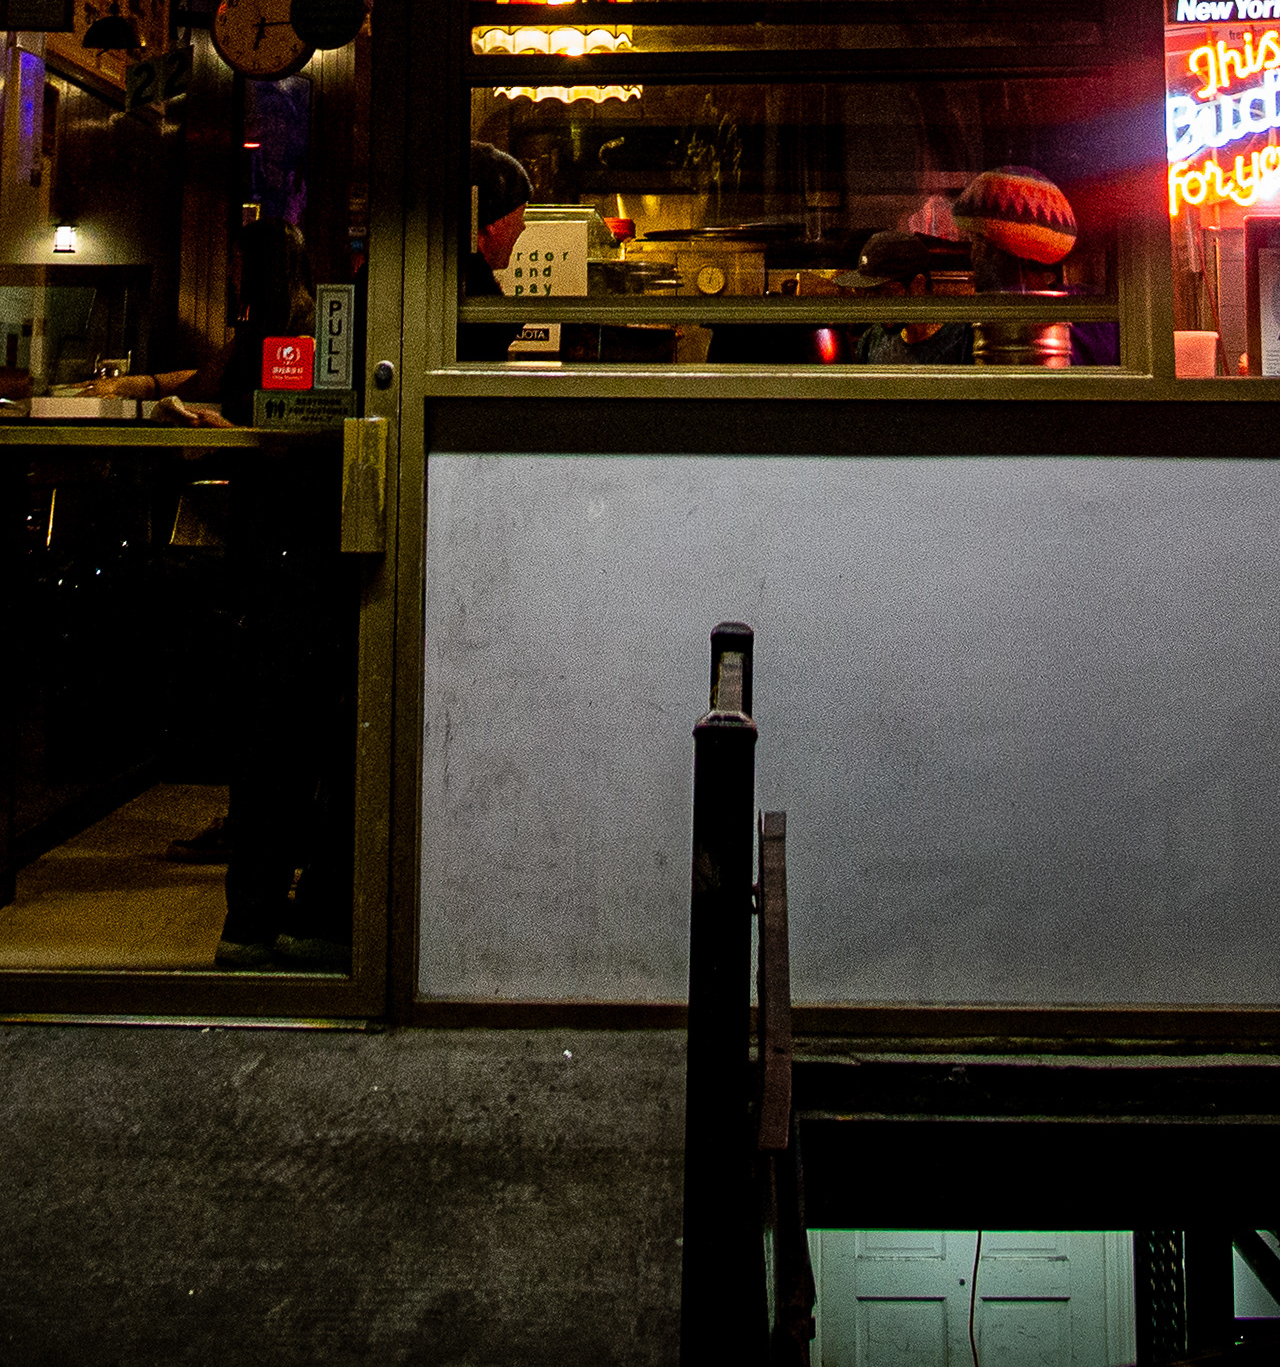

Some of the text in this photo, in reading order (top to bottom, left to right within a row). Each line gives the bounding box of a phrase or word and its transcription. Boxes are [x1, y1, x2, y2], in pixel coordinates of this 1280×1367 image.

[1167, 159, 1236, 216] for
[514, 265, 552, 278] and
[514, 283, 552, 297] pay
[327, 300, 343, 374] PULL
